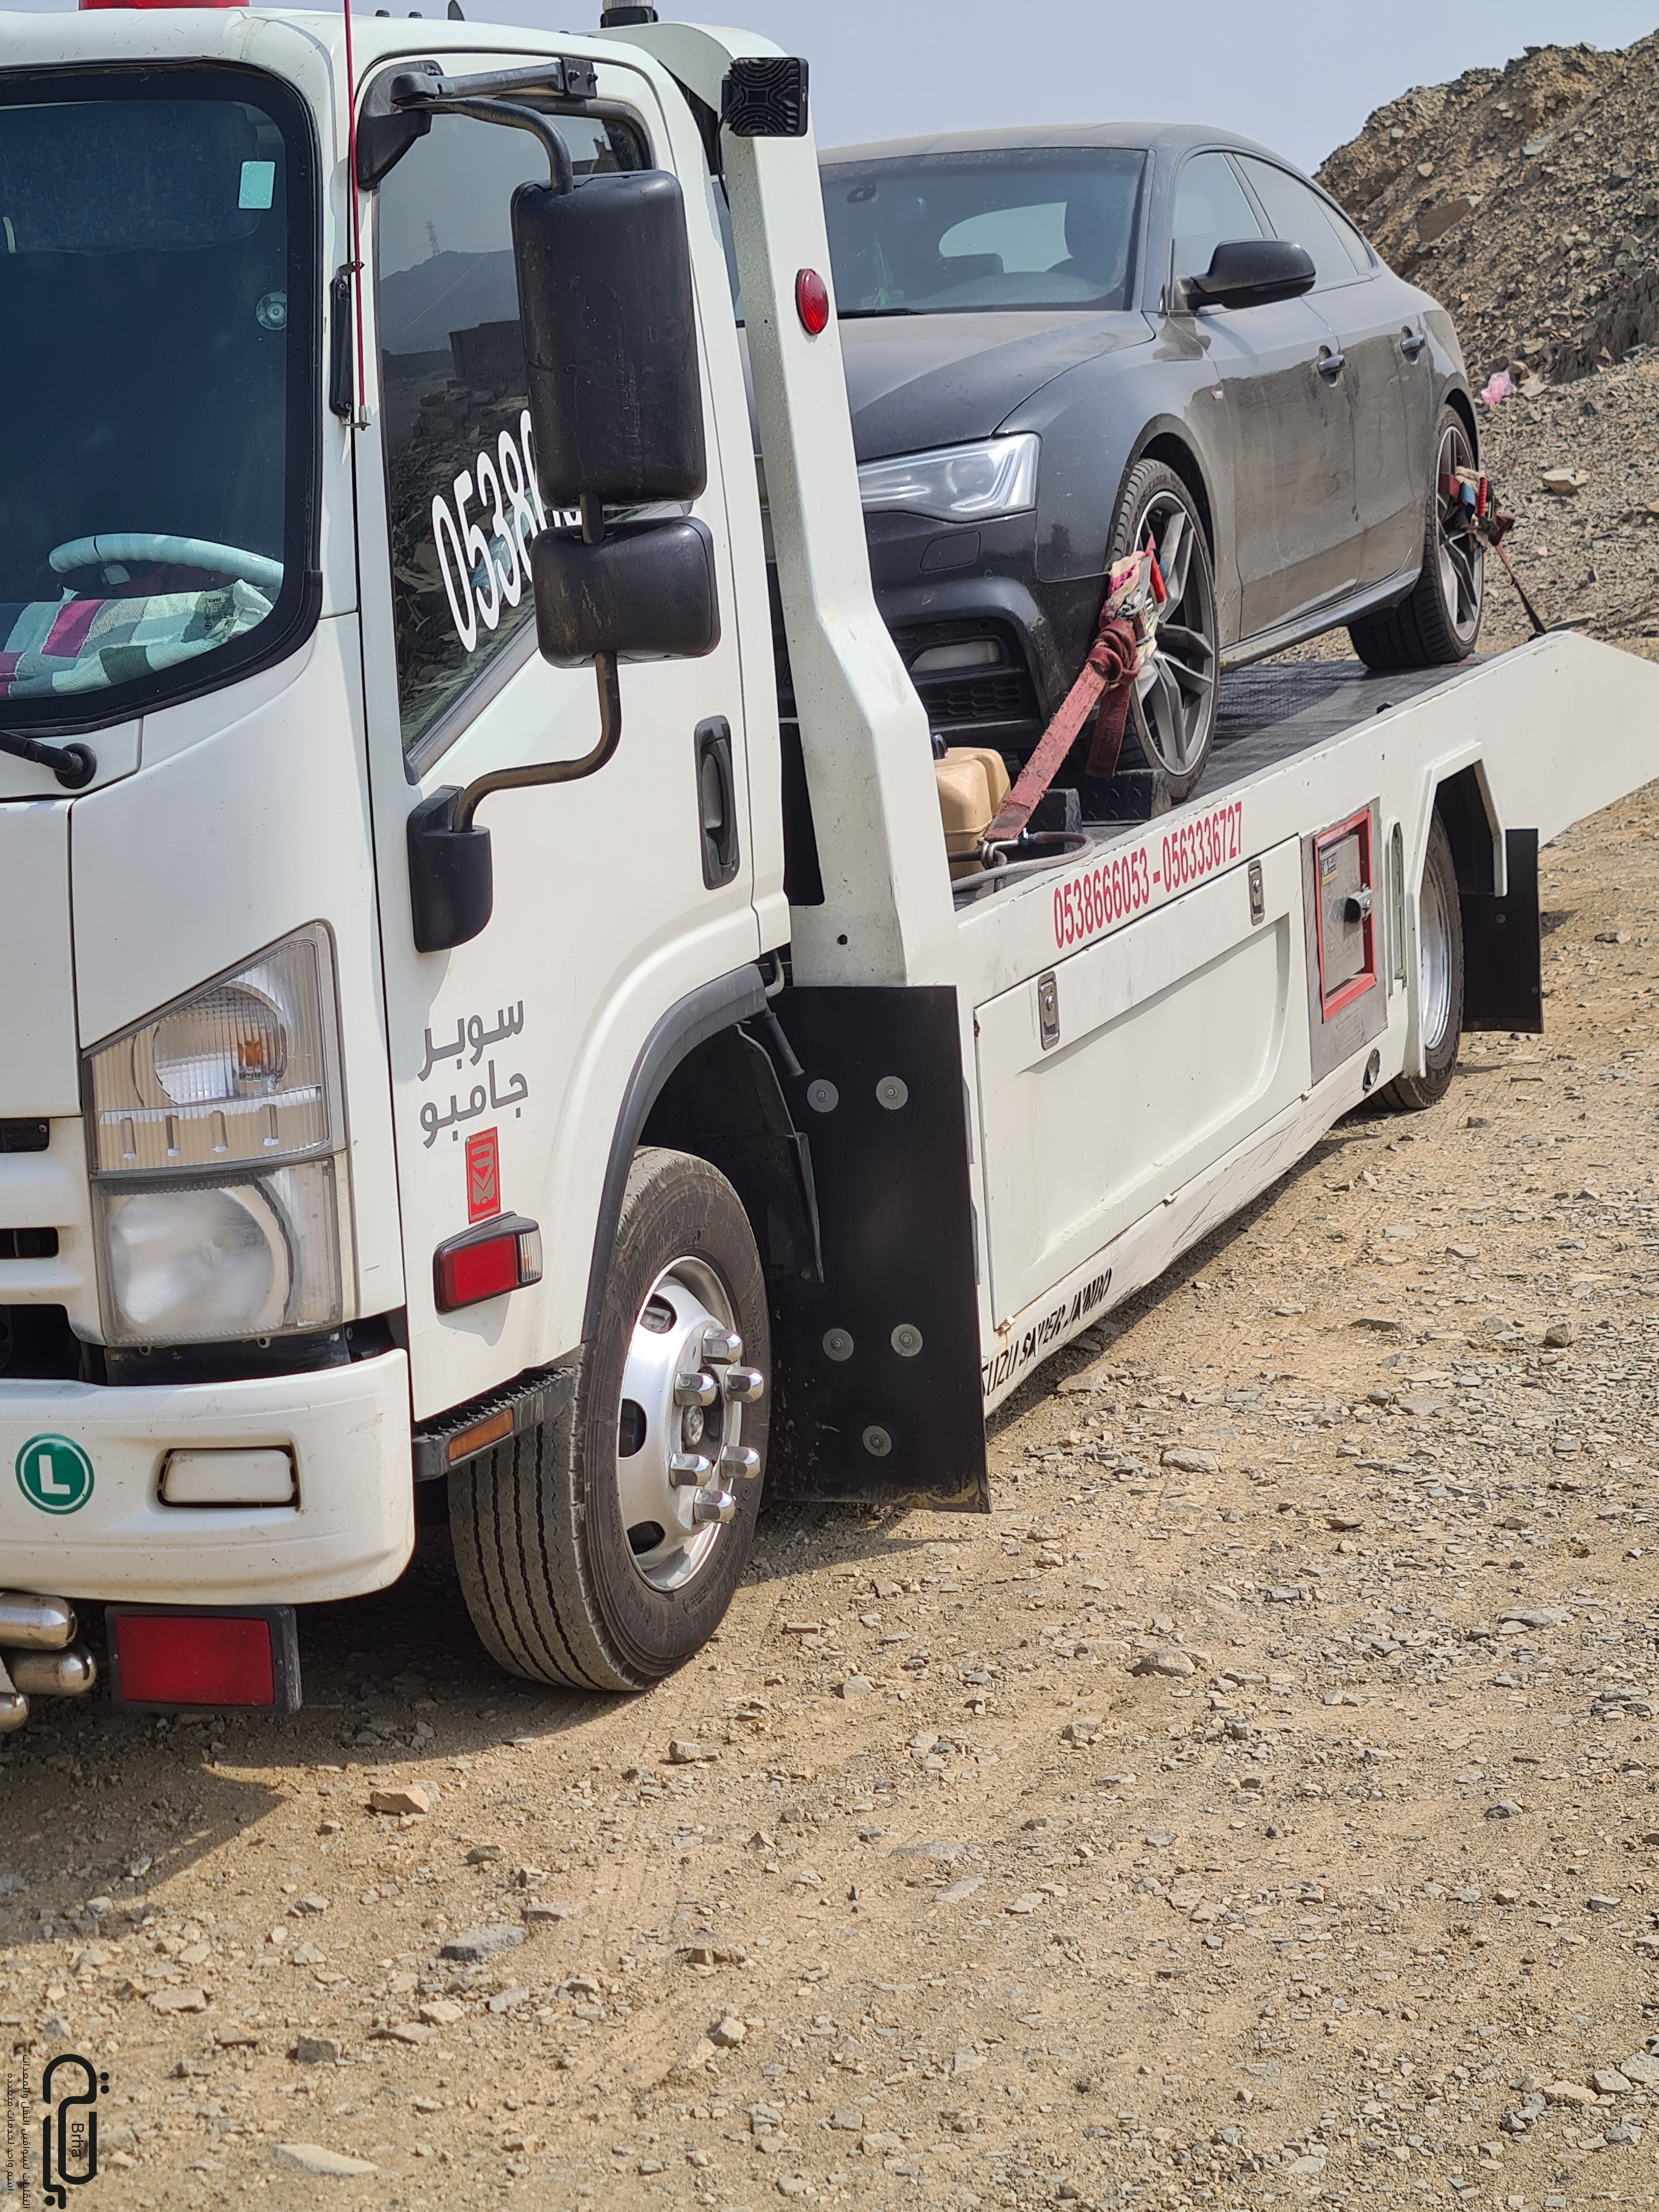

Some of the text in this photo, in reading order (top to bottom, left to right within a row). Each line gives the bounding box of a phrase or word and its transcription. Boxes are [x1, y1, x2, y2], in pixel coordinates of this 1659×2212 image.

[432, 409, 583, 652] 0538
[1053, 848, 1149, 949] 0538666053
[1163, 801, 1242, 893] 0563336727
[417, 1000, 524, 1082] سوبر
[419, 1059, 529, 1149] جامبو
[38, 1454, 70, 1495] L
